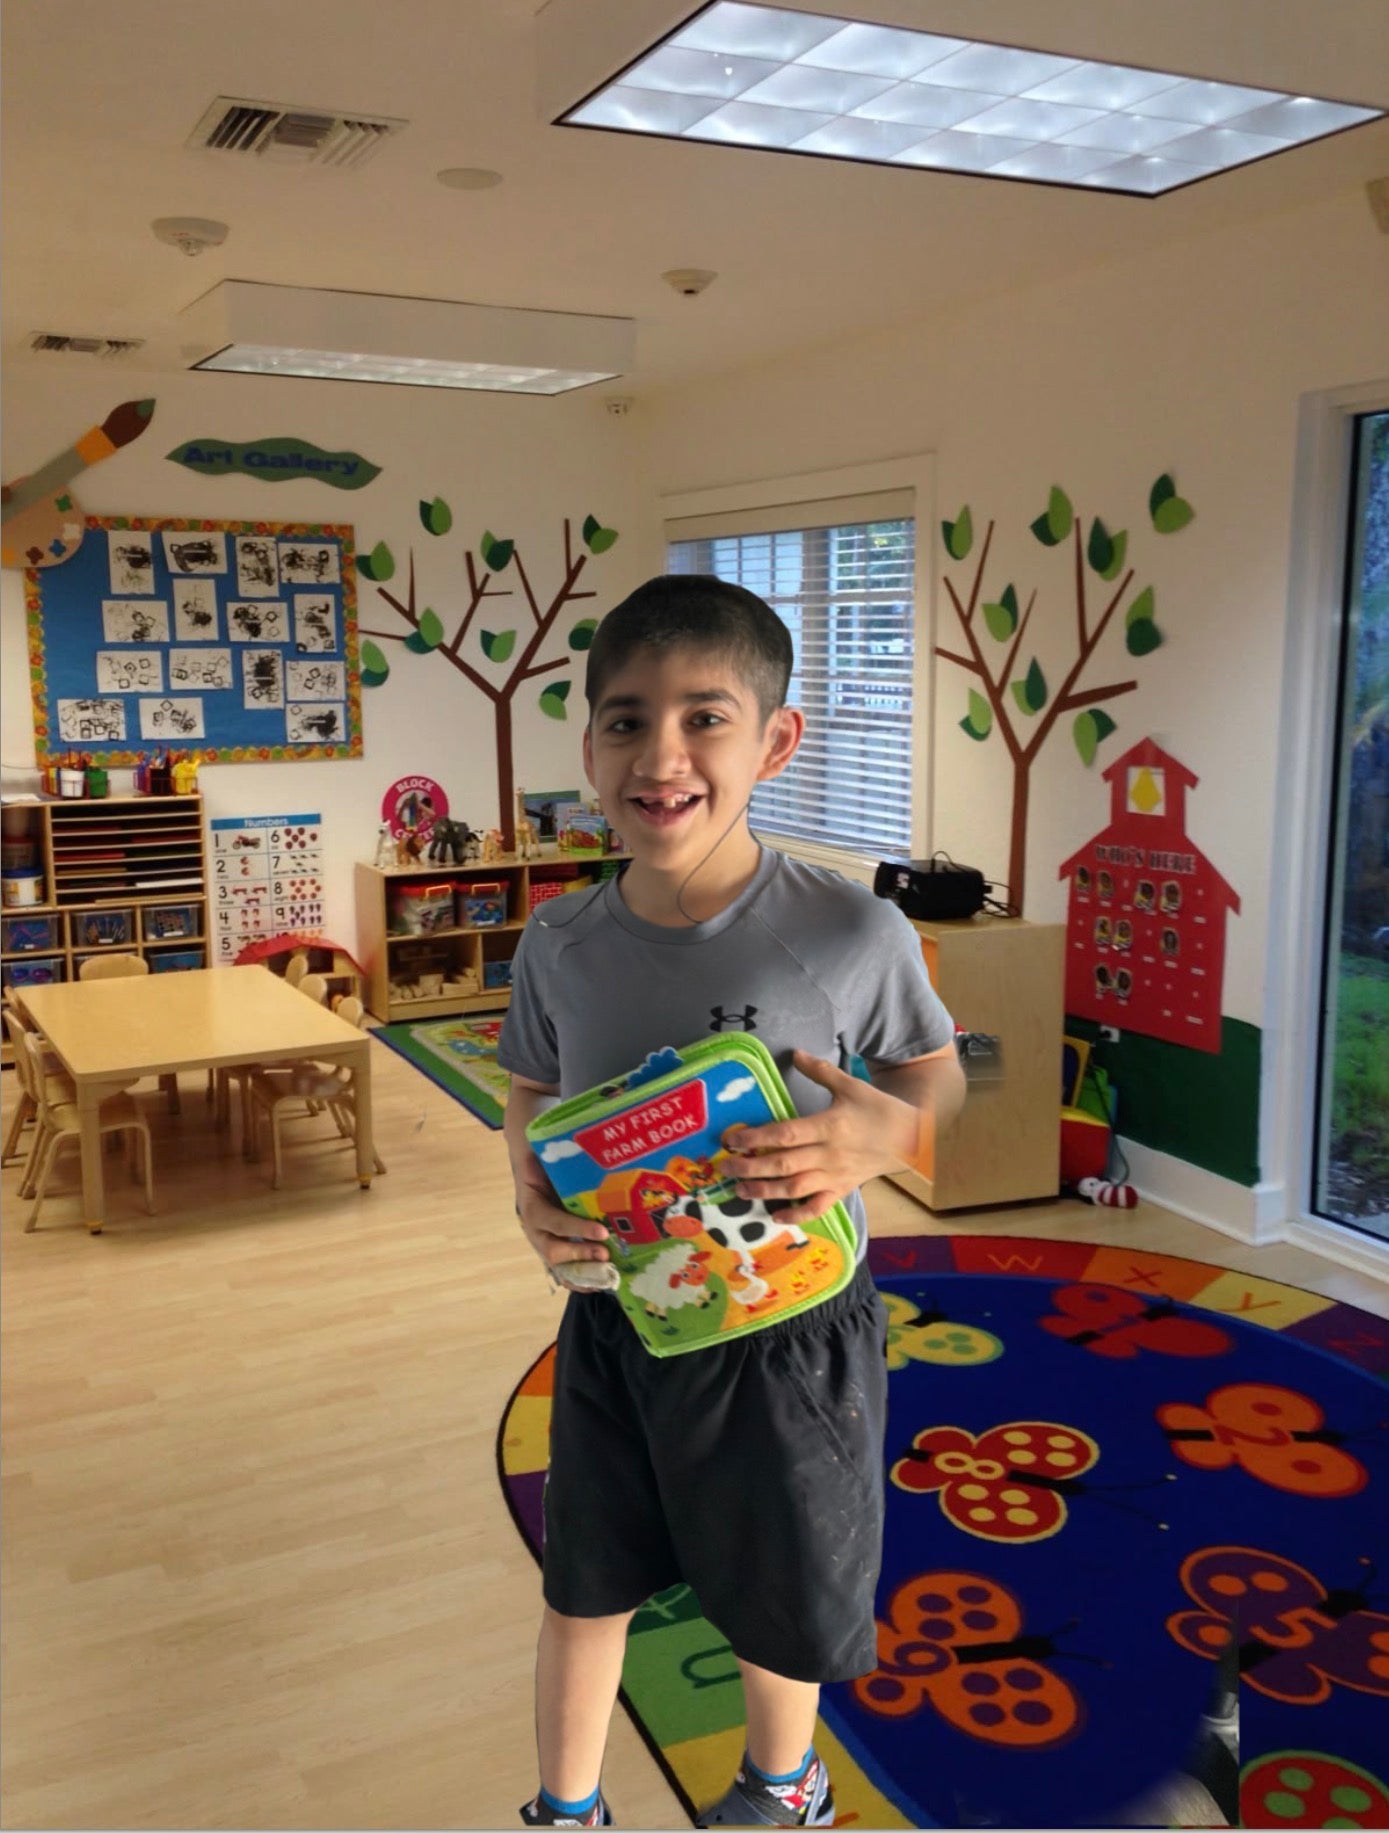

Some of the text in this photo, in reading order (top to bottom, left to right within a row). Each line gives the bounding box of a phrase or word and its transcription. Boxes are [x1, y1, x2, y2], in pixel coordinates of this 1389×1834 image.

[183, 445, 360, 477] Art Gallery
[395, 778, 435, 793] BLOCK
[244, 817, 289, 828] Numbers
[214, 833, 220, 848] 1
[271, 829, 280, 843] 6
[216, 859, 226, 873] 2
[271, 855, 281, 869] 7
[1149, 850, 1198, 875] HERE
[218, 885, 228, 899] 3
[274, 881, 283, 895] 8
[219, 911, 229, 925] 4
[275, 907, 286, 920] 9
[221, 936, 231, 950] 5
[602, 1096, 683, 1142] MY FIRST
[601, 1113, 698, 1163] FARM BOOK
[933, 1450, 1006, 1482] 8
[1249, 1606, 1338, 1650] 5
